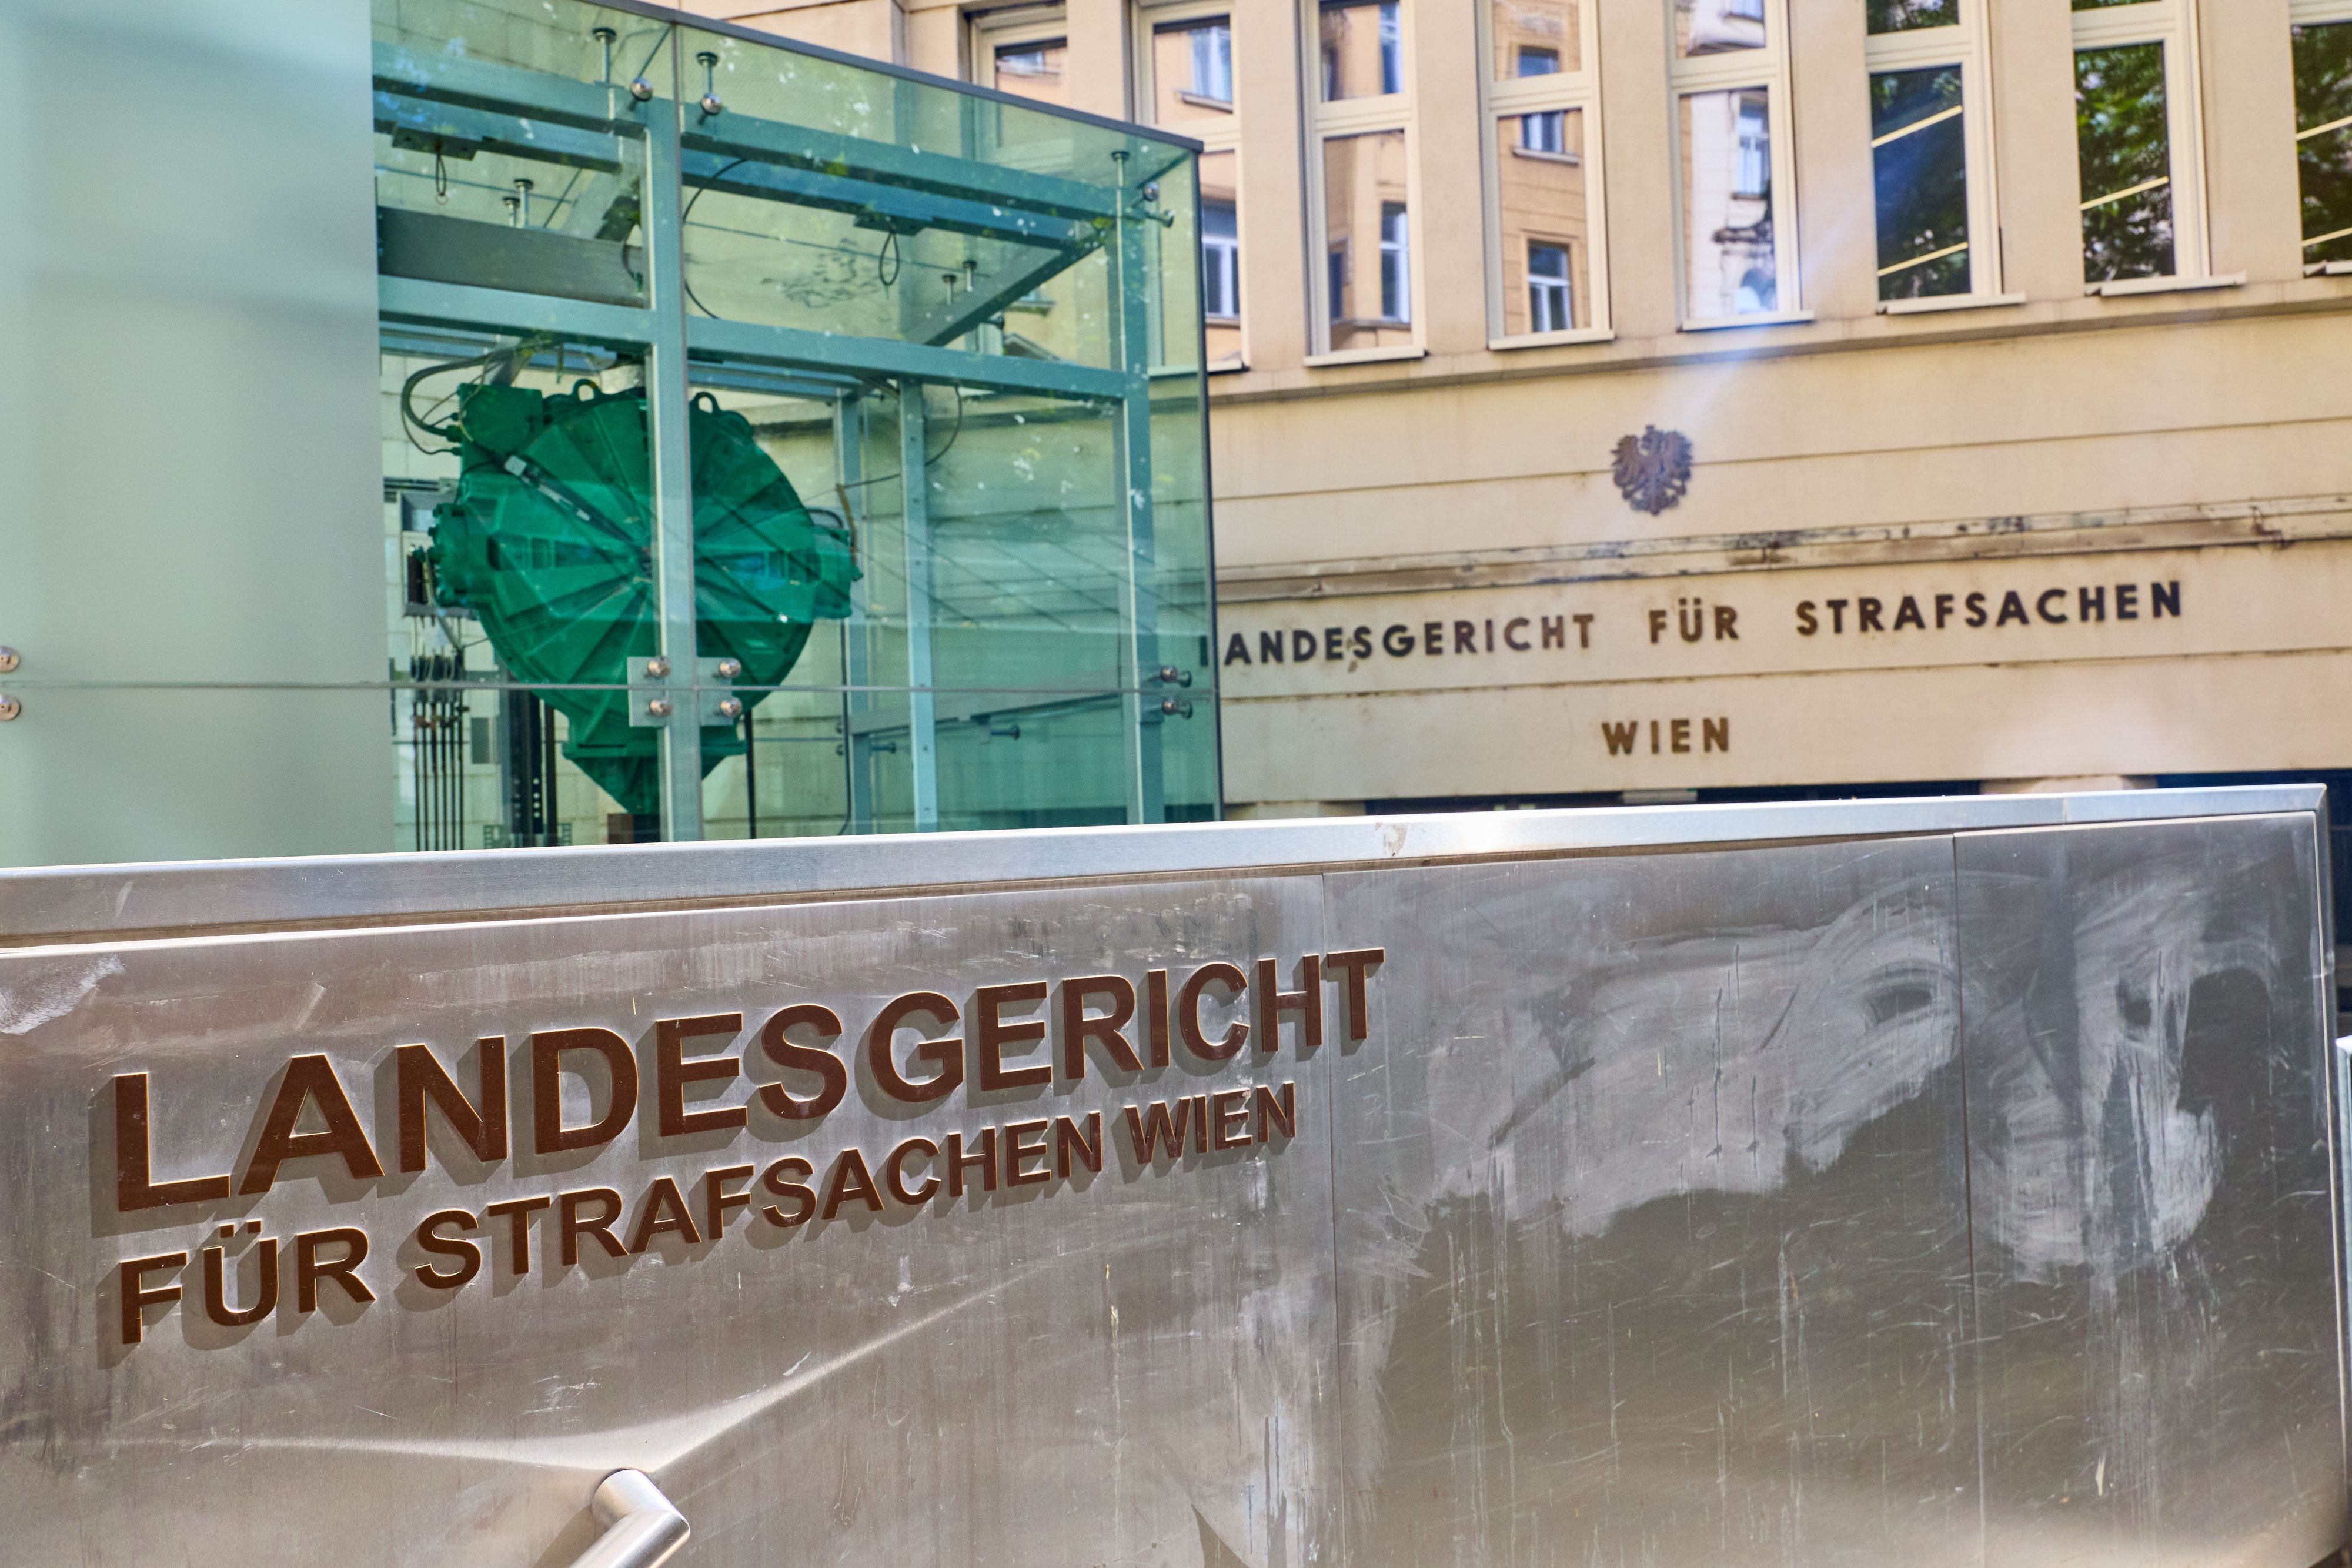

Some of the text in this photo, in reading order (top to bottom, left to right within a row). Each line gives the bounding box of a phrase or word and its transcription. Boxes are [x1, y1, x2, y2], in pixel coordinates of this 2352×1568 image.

[1649, 599, 1740, 644] FÜR
[1796, 581, 2182, 636] STRAFSACHEN
[1602, 717, 1730, 756] WIEN
[113, 947, 1384, 1212] LANDESGERICHT
[118, 1081, 1296, 1345] FÜR STRAFSACHEN WIEN
